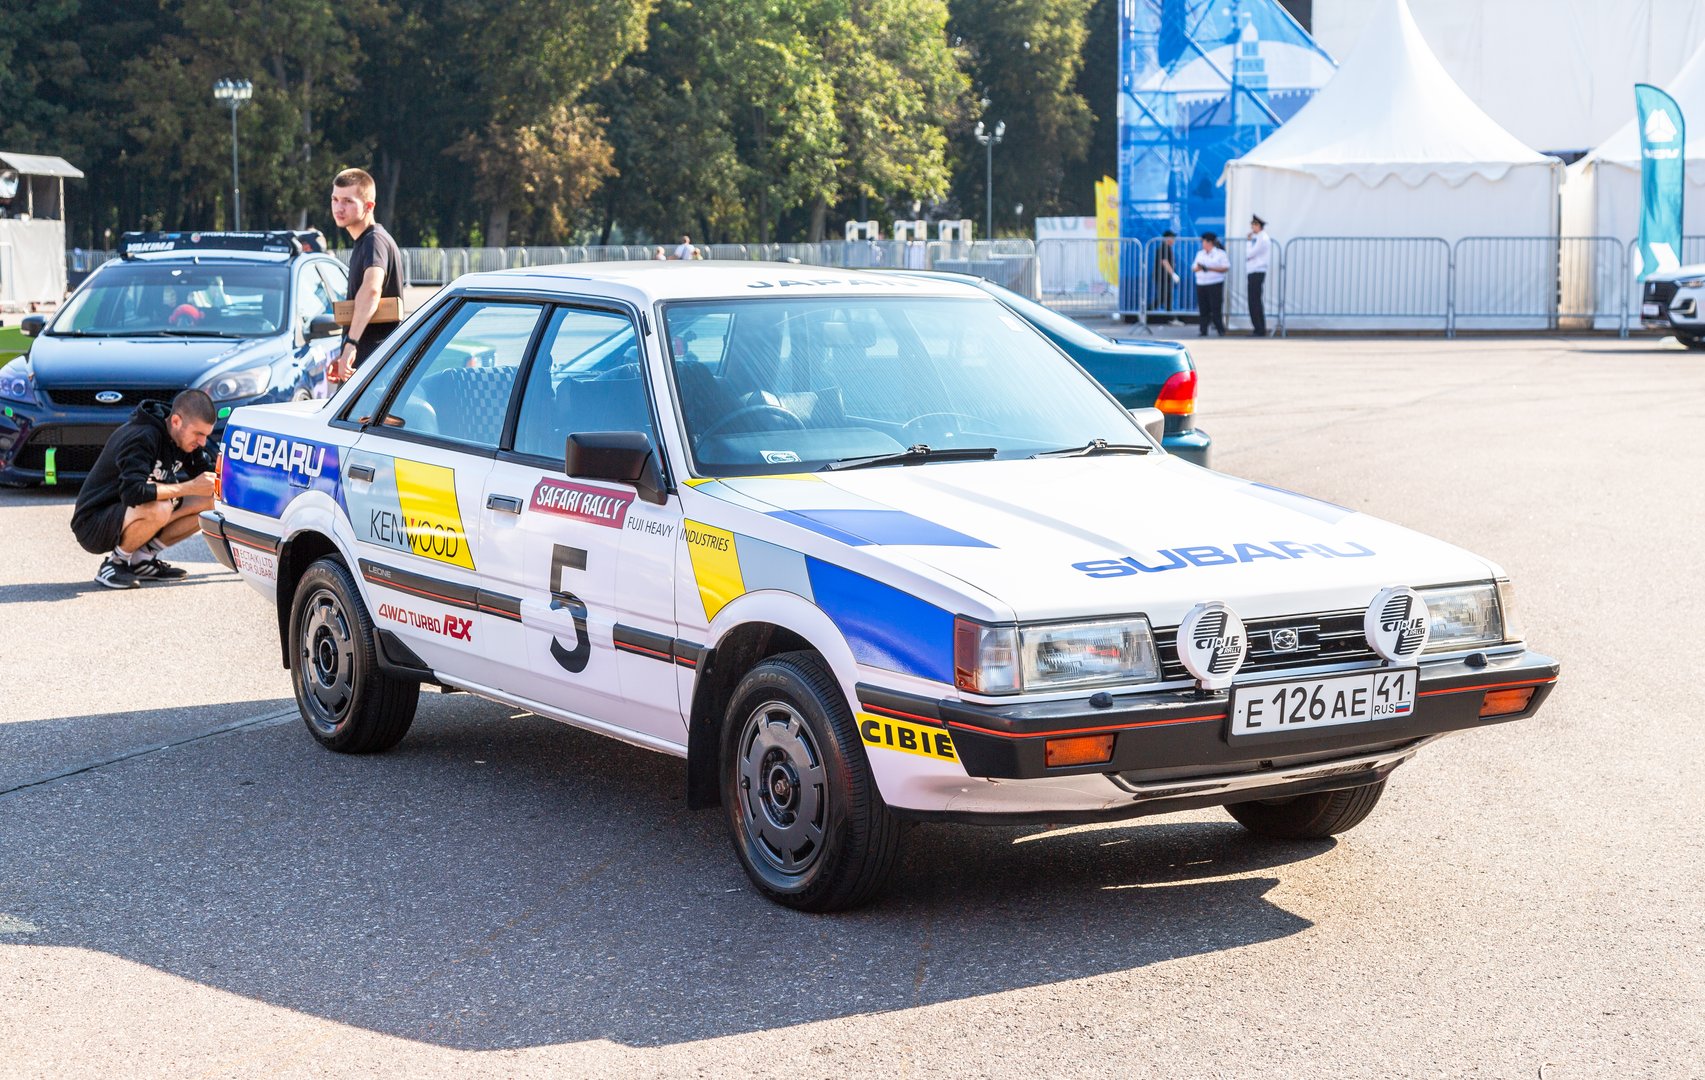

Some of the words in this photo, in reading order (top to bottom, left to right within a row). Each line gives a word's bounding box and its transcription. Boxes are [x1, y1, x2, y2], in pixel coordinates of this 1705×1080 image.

[126, 241, 175, 253] YAKIMA
[747, 279, 919, 289] JAPAN
[228, 430, 326, 478] SUBARU
[536, 485, 583, 513] SAFARI
[581, 493, 626, 520] RALLY
[370, 508, 459, 558] KENWOOD
[627, 516, 645, 530] FUJI
[645, 521, 674, 538] HEAVY
[679, 528, 730, 552] INDUSTRIES
[262, 556, 273, 569] LTD
[1071, 540, 1377, 579] SUBARU
[242, 560, 254, 572] FOR
[254, 564, 277, 581] SUBARU
[368, 565, 392, 579] LEONE
[550, 543, 591, 673] 5
[378, 603, 408, 624] 4WD
[408, 611, 441, 634] TURBO
[443, 614, 473, 642] RX
[1382, 617, 1424, 632] CIBIE
[1195, 635, 1240, 650] CIBIE
[1223, 646, 1241, 654] RALLY
[1377, 674, 1405, 703] 41
[1374, 703, 1395, 716] RUS
